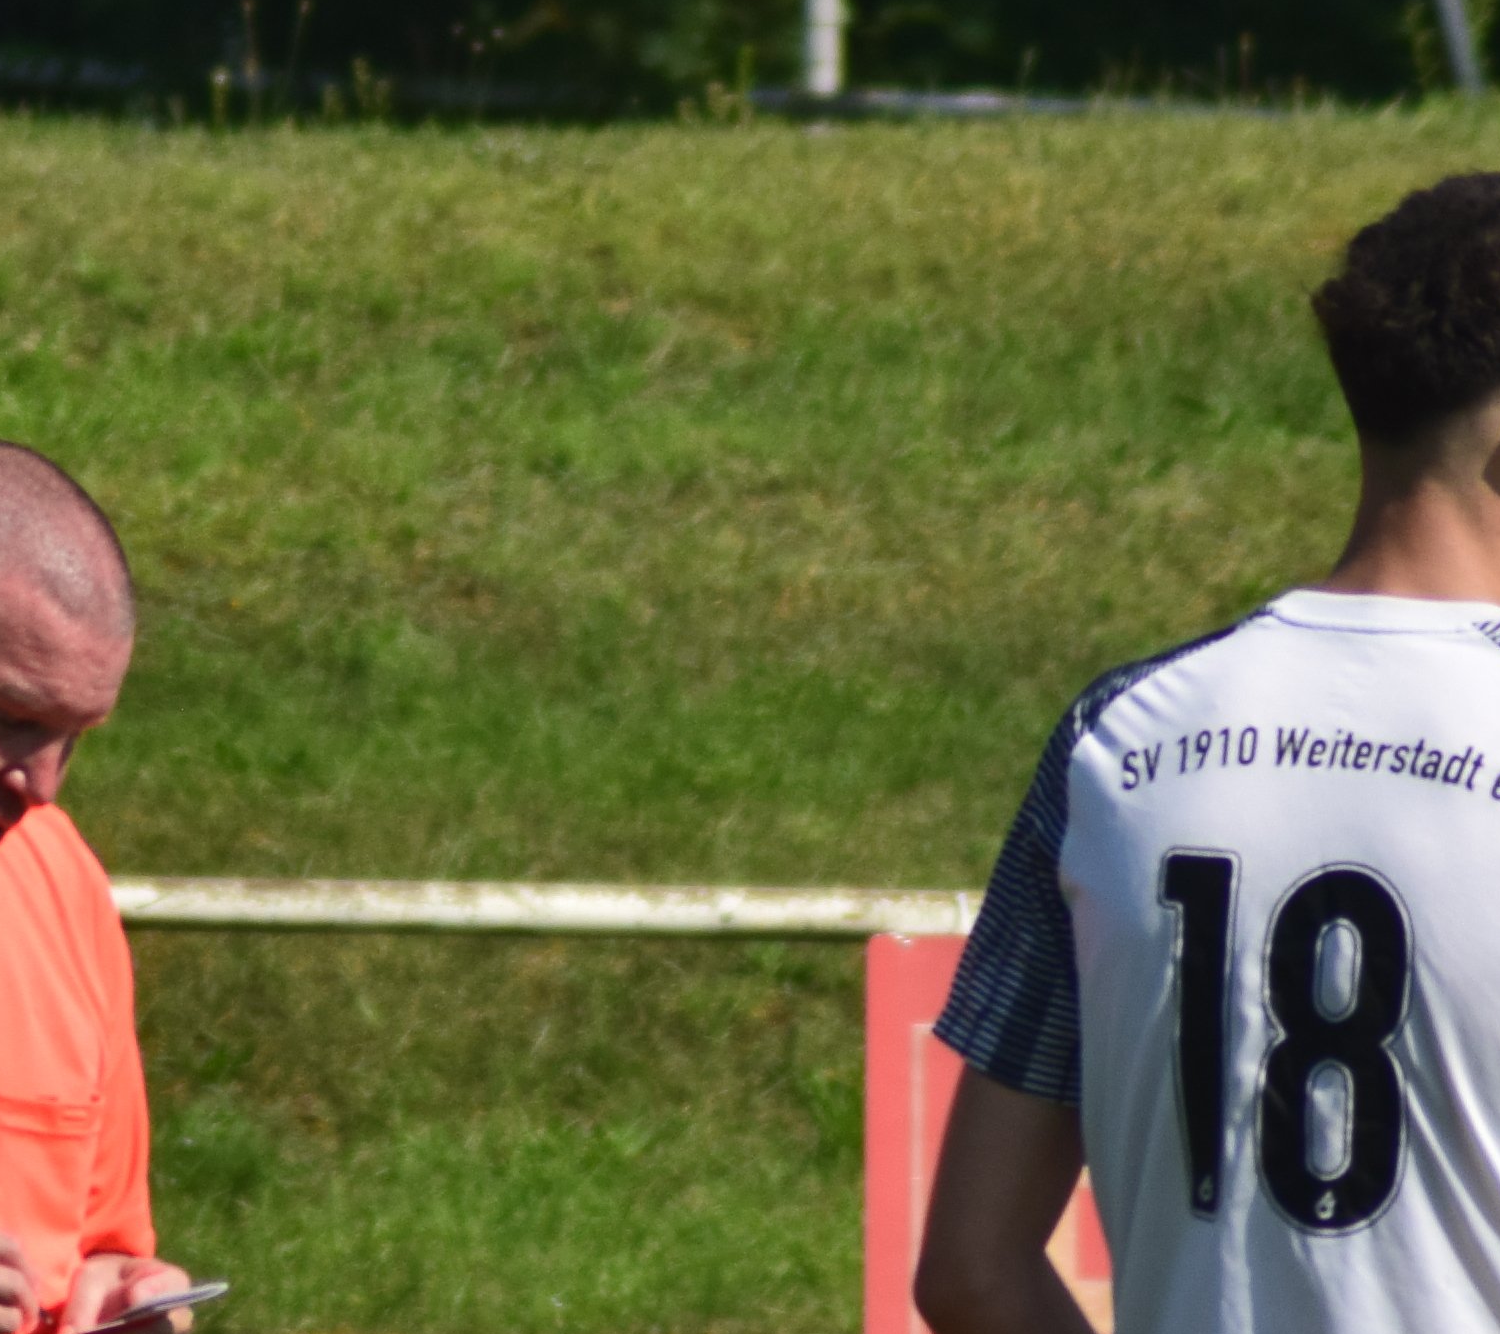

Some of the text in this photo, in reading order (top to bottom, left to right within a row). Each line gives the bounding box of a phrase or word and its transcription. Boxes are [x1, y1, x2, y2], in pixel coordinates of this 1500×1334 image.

[1120, 742, 1162, 791] SV
[1176, 725, 1258, 775] 1910
[1274, 726, 1486, 792] Weiterstadt
[1160, 845, 1415, 1237] 18
